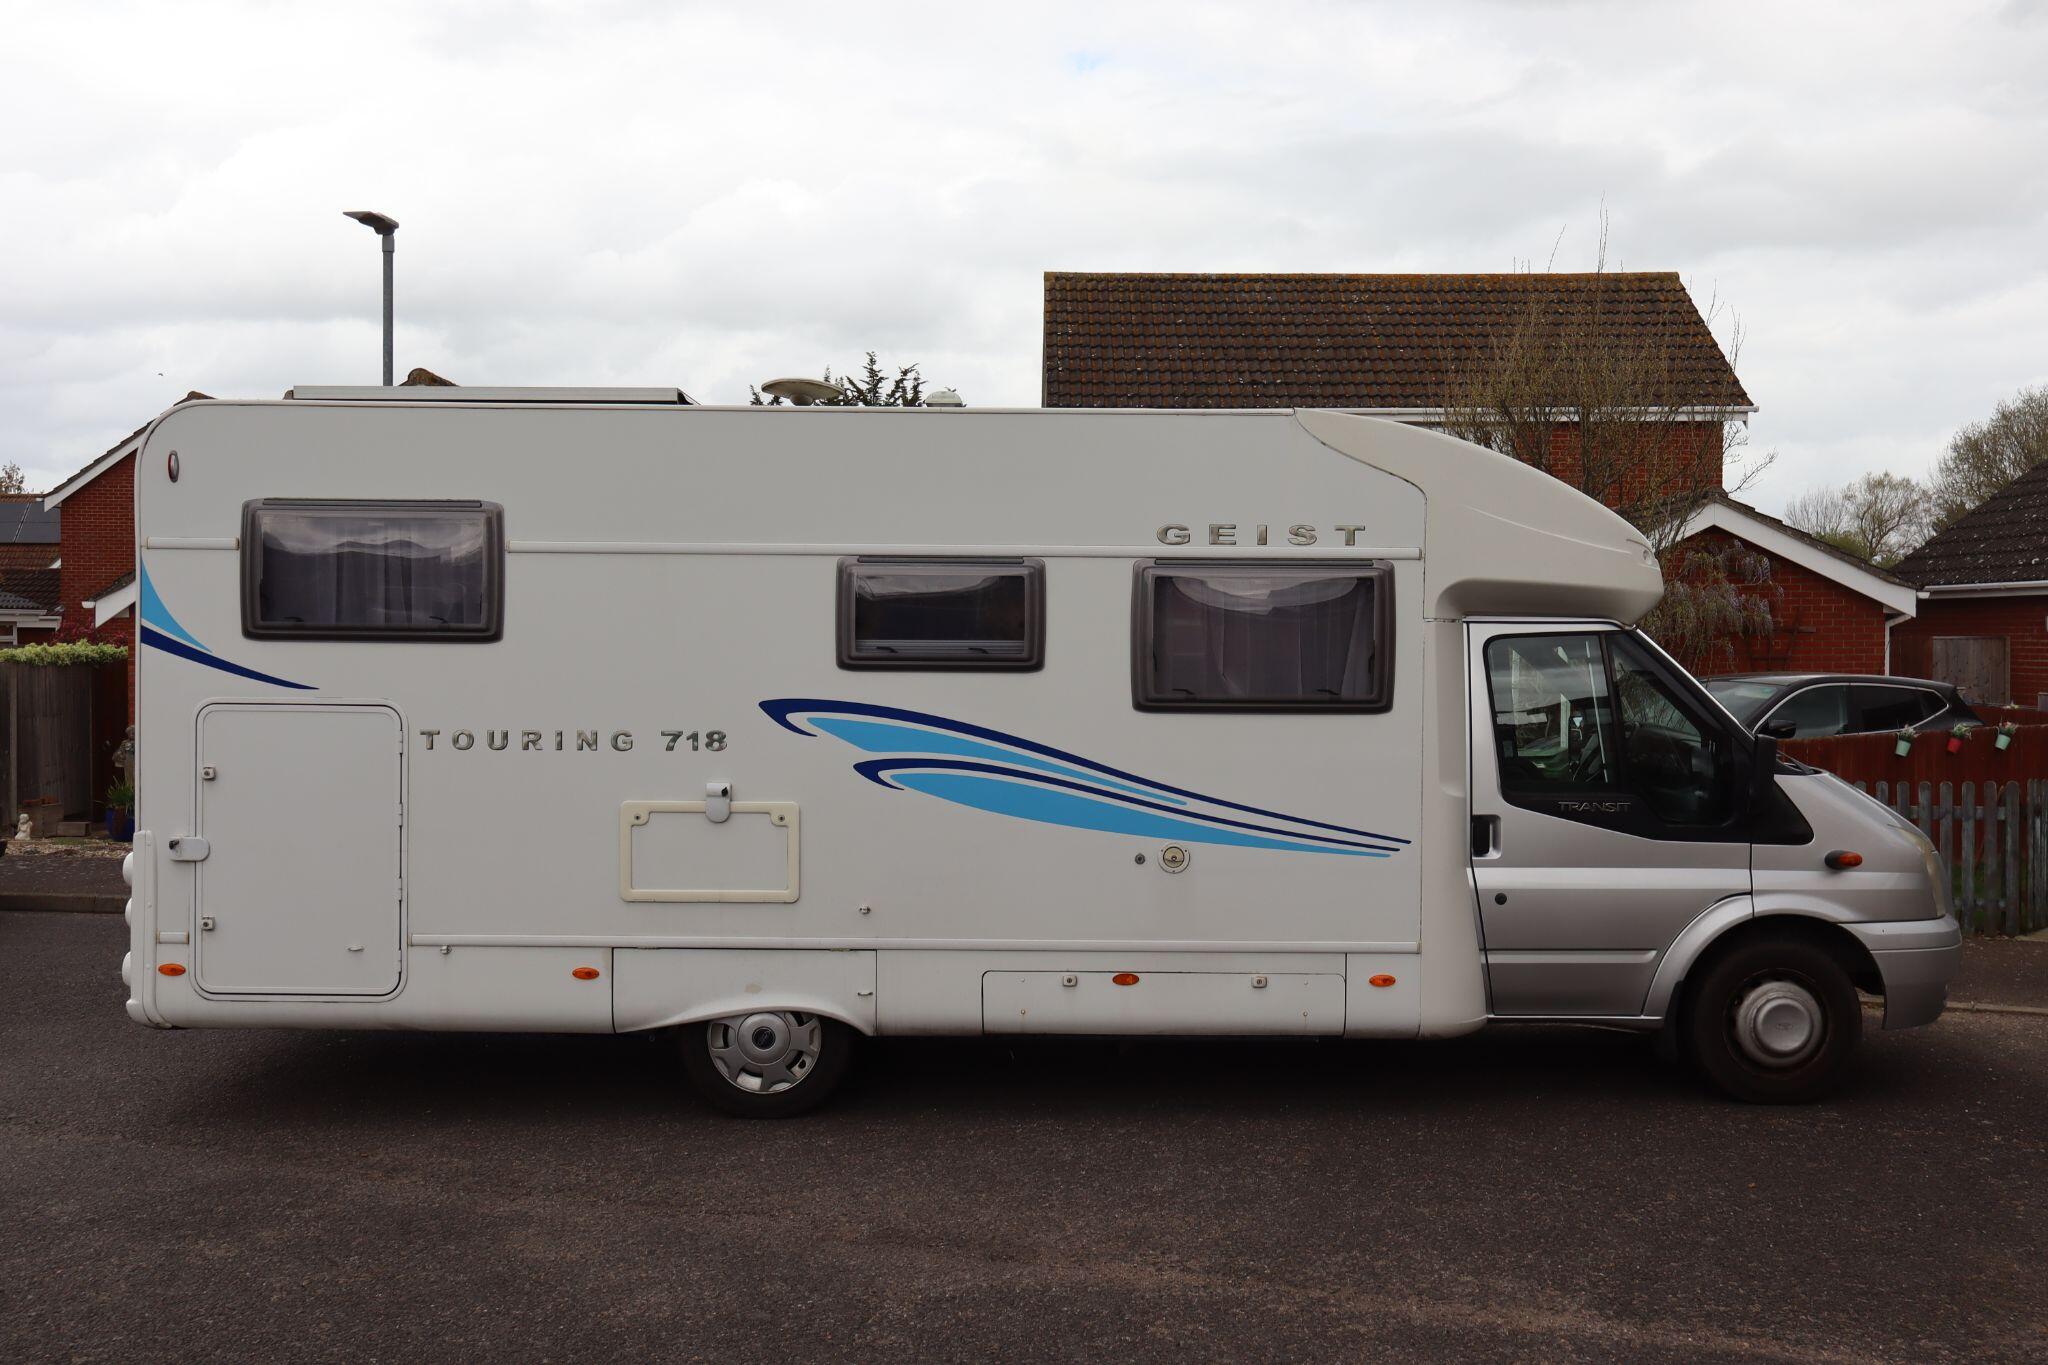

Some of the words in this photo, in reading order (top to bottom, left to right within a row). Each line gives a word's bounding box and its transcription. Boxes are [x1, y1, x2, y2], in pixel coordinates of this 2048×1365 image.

[1156, 523, 1366, 546] GEIST
[419, 729, 634, 751] TOURING
[660, 729, 728, 751] 718
[1558, 801, 1632, 813] TRANSIT
